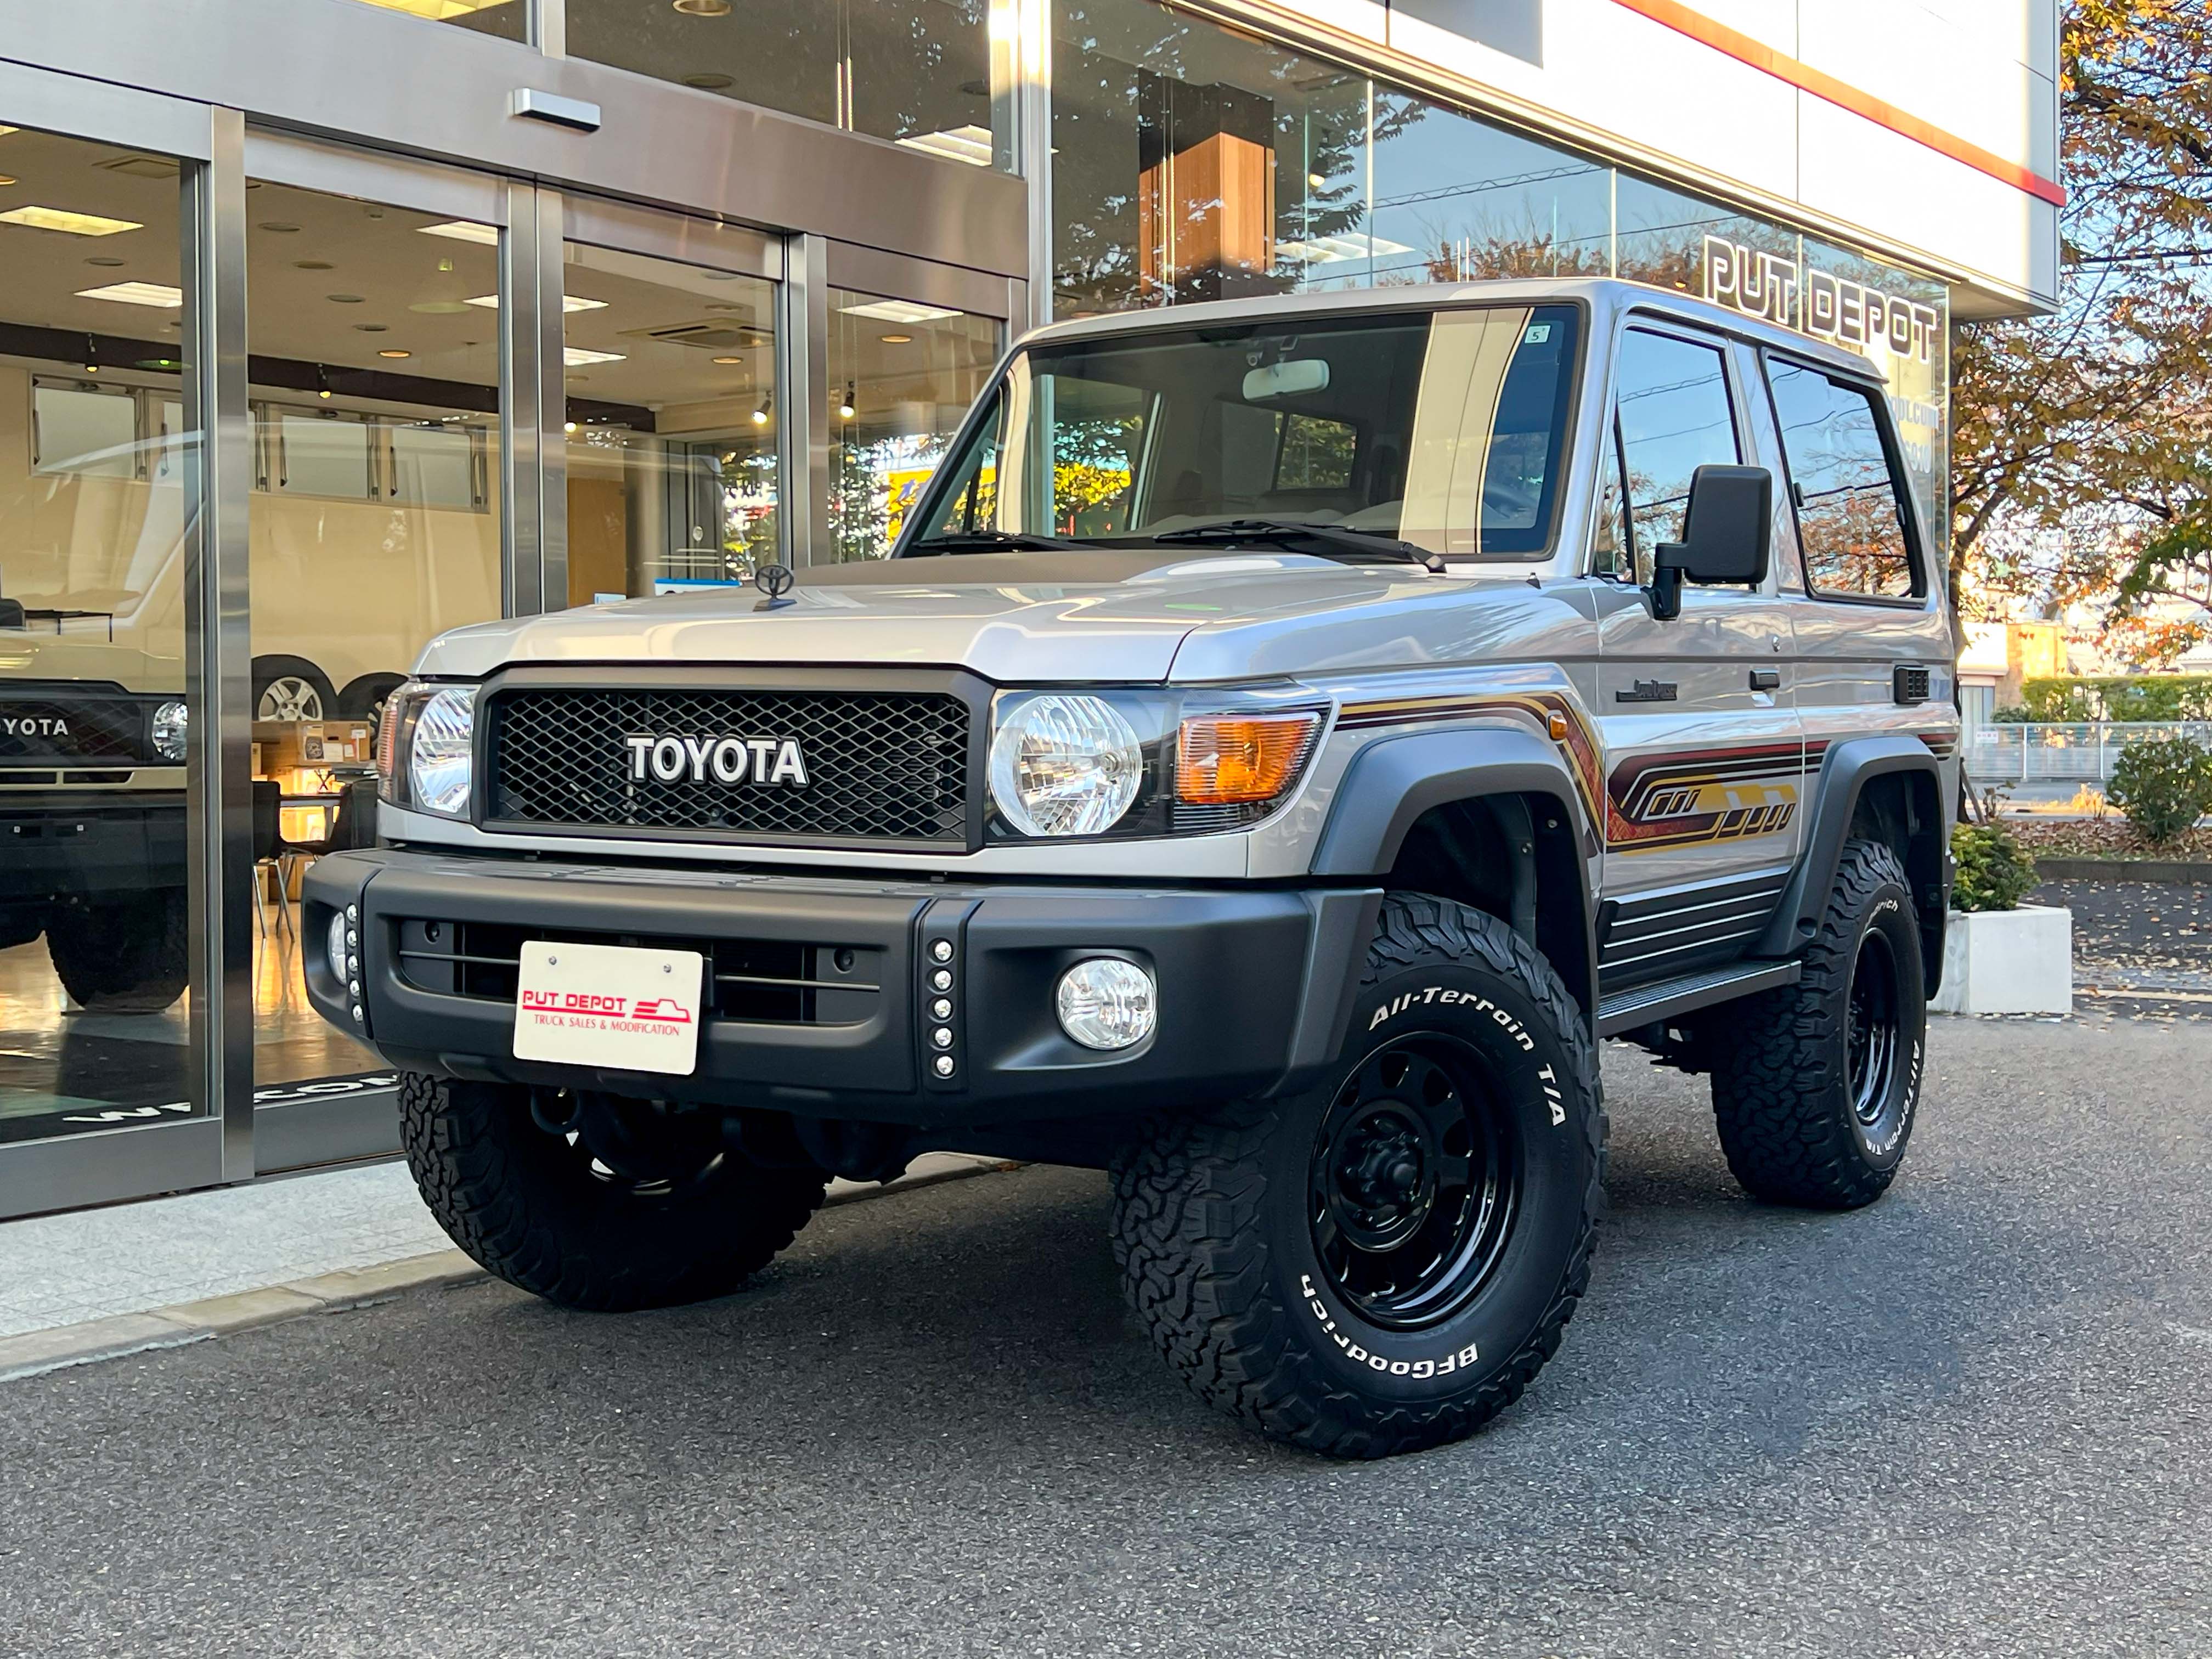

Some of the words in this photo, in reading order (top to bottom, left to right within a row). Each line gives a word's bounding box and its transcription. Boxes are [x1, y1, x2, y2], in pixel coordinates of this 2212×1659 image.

[1704, 234, 1797, 324] PUT
[1808, 268, 1937, 364] DEPOT
[0, 718, 69, 736] YOTA
[626, 735, 808, 786] TOYOTA
[522, 990, 559, 1006] PUT
[565, 994, 627, 1011] DEPOT
[534, 1014, 565, 1027] TRUCK
[569, 1018, 596, 1030] SALES
[600, 1020, 607, 1030] &
[610, 1020, 680, 1036] MODIFICATION
[1368, 986, 1534, 1051] All-Terrain
[1537, 1062, 1566, 1126] T/A
[1301, 1273, 1479, 1379] BFGoodrich
